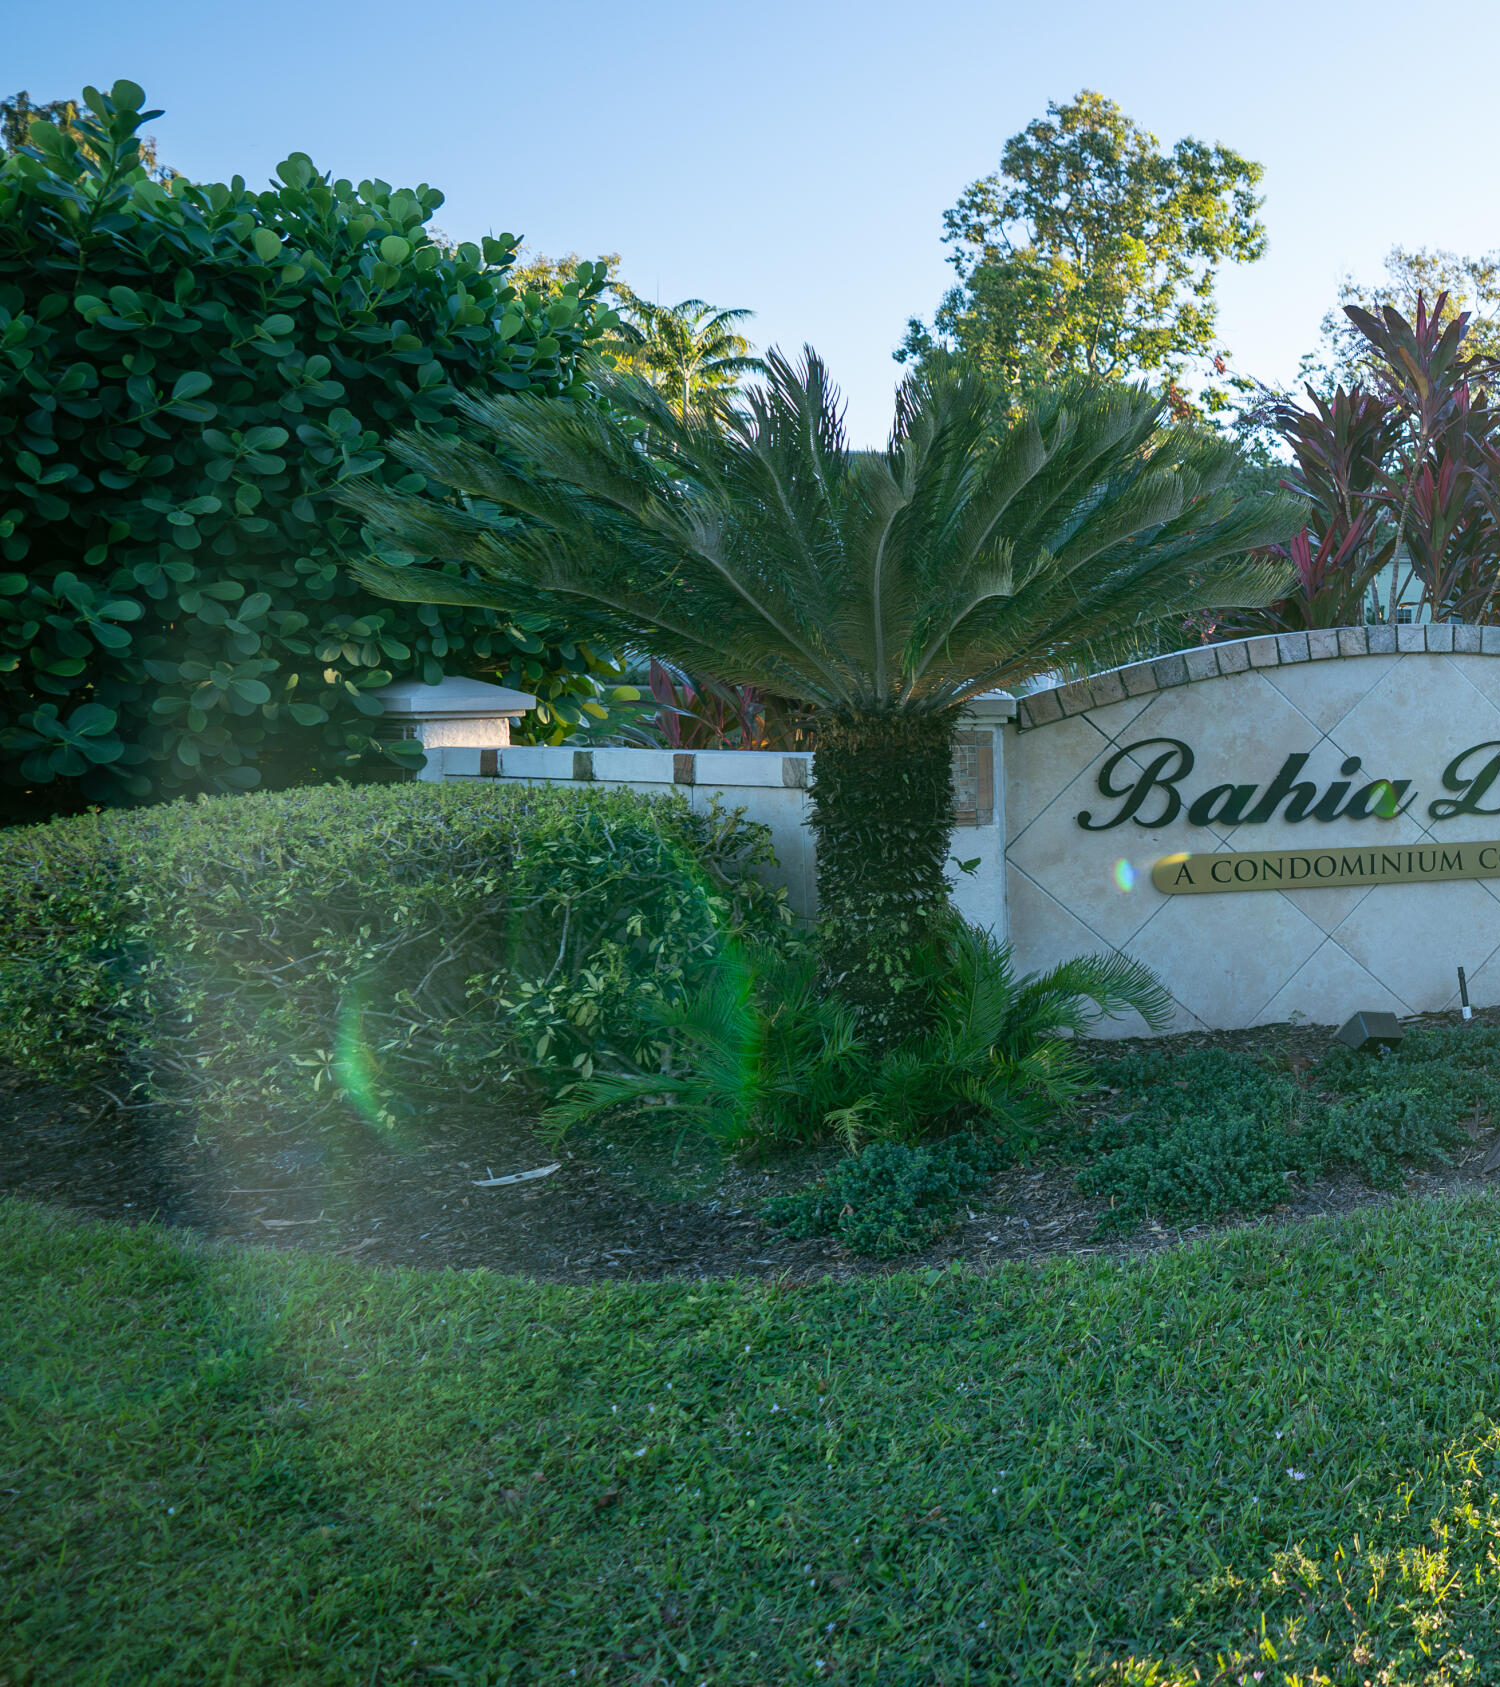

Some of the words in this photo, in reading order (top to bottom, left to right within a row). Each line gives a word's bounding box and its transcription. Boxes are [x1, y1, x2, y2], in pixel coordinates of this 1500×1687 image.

[1077, 738, 1419, 831] Bahia
[1173, 861, 1197, 886] A
[1210, 849, 1465, 884] CONDOMINIUM
